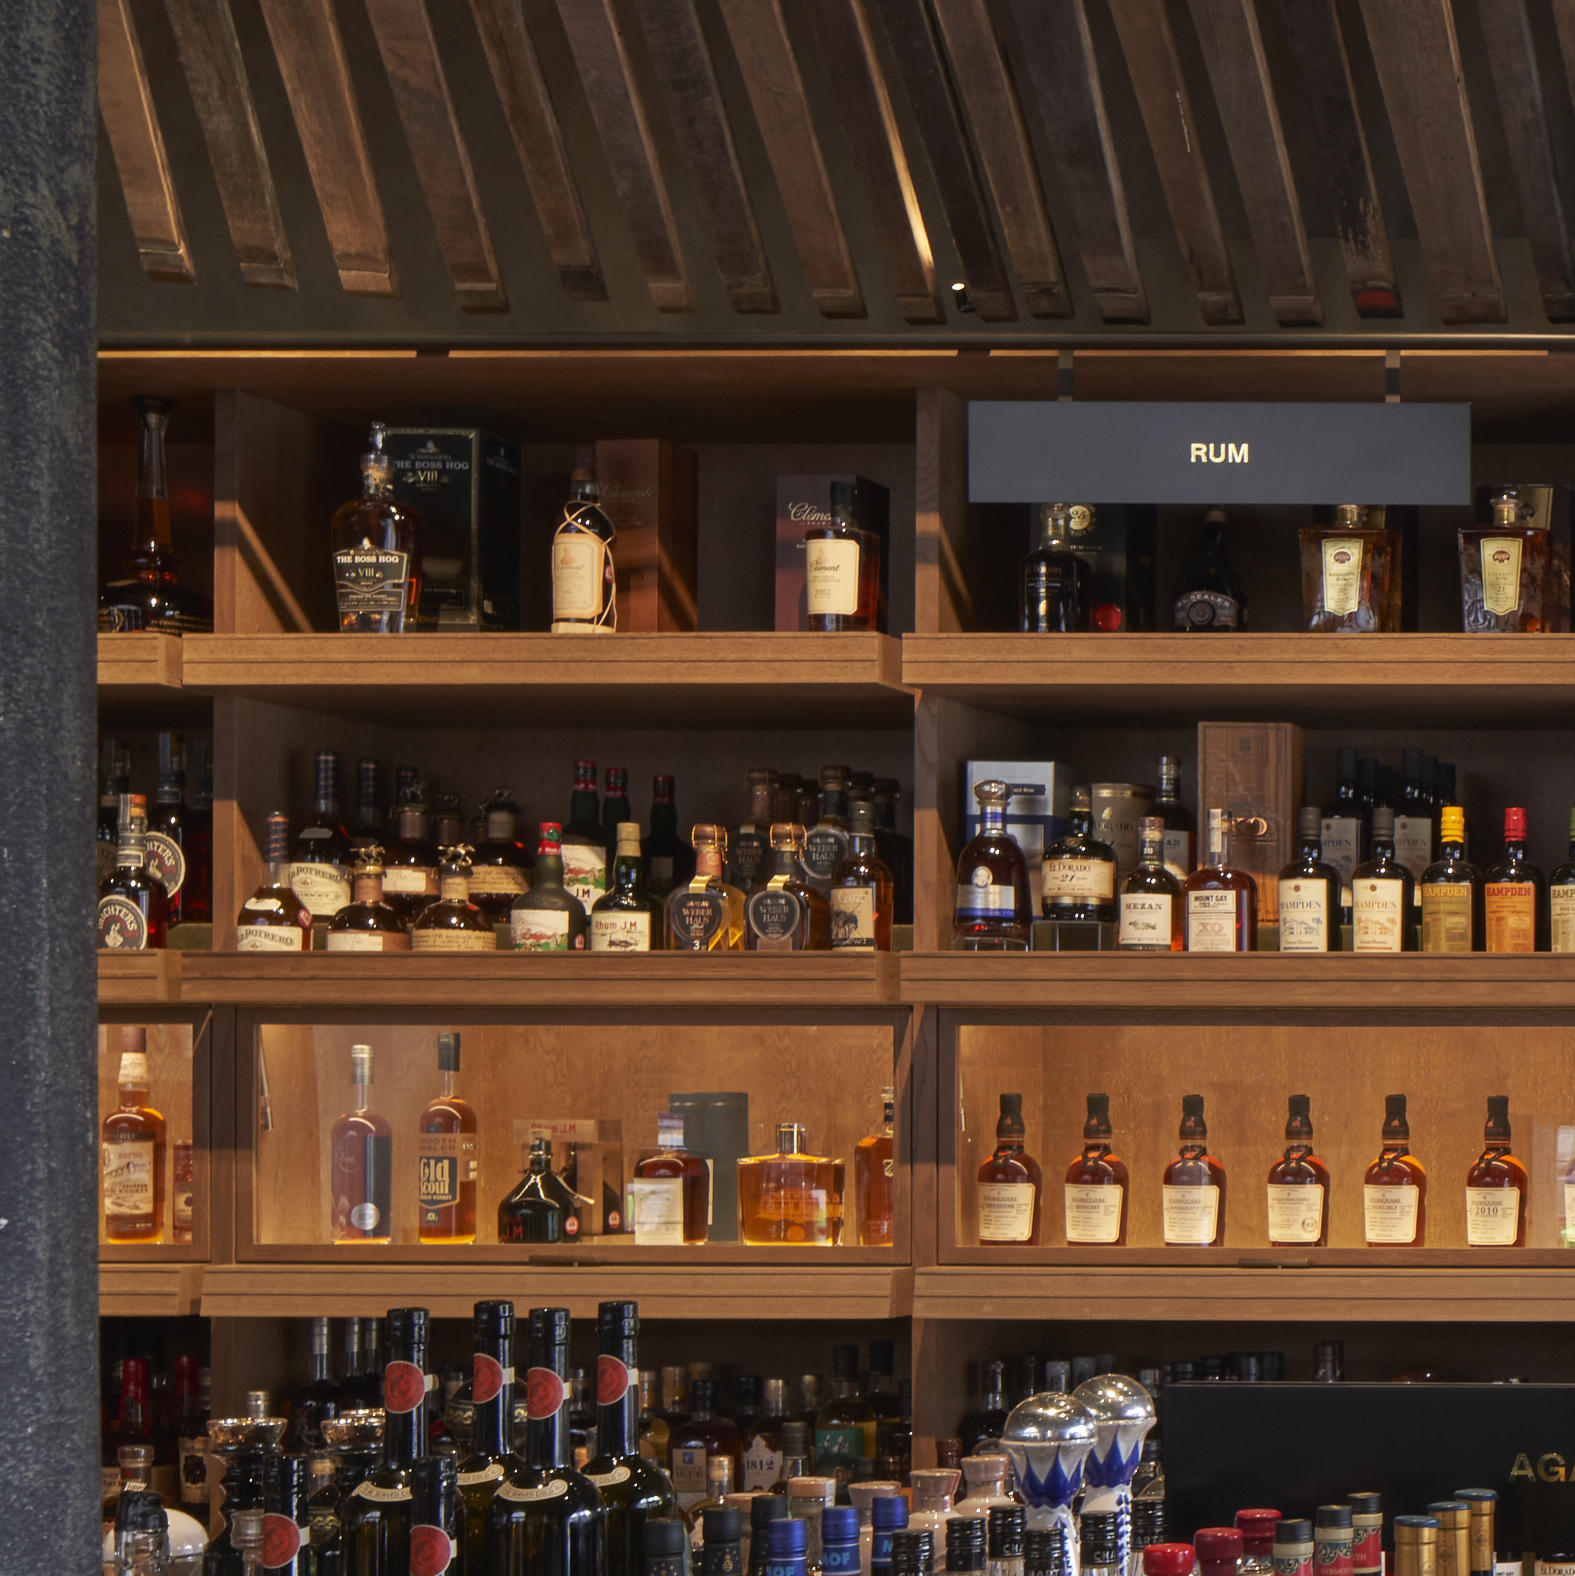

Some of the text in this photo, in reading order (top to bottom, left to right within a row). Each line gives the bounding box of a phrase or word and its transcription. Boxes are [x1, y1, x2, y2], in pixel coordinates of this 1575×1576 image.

[1190, 443, 1249, 463] RUM
[337, 555, 399, 564] THE BOSS HOG
[358, 568, 374, 577] VIII
[1486, 886, 1532, 897] HAMPDEN
[1125, 903, 1163, 911] MEZAN
[1199, 922, 1224, 933] XO
[1475, 1206, 1499, 1215] 2010
[745, 1459, 774, 1472] 1812
